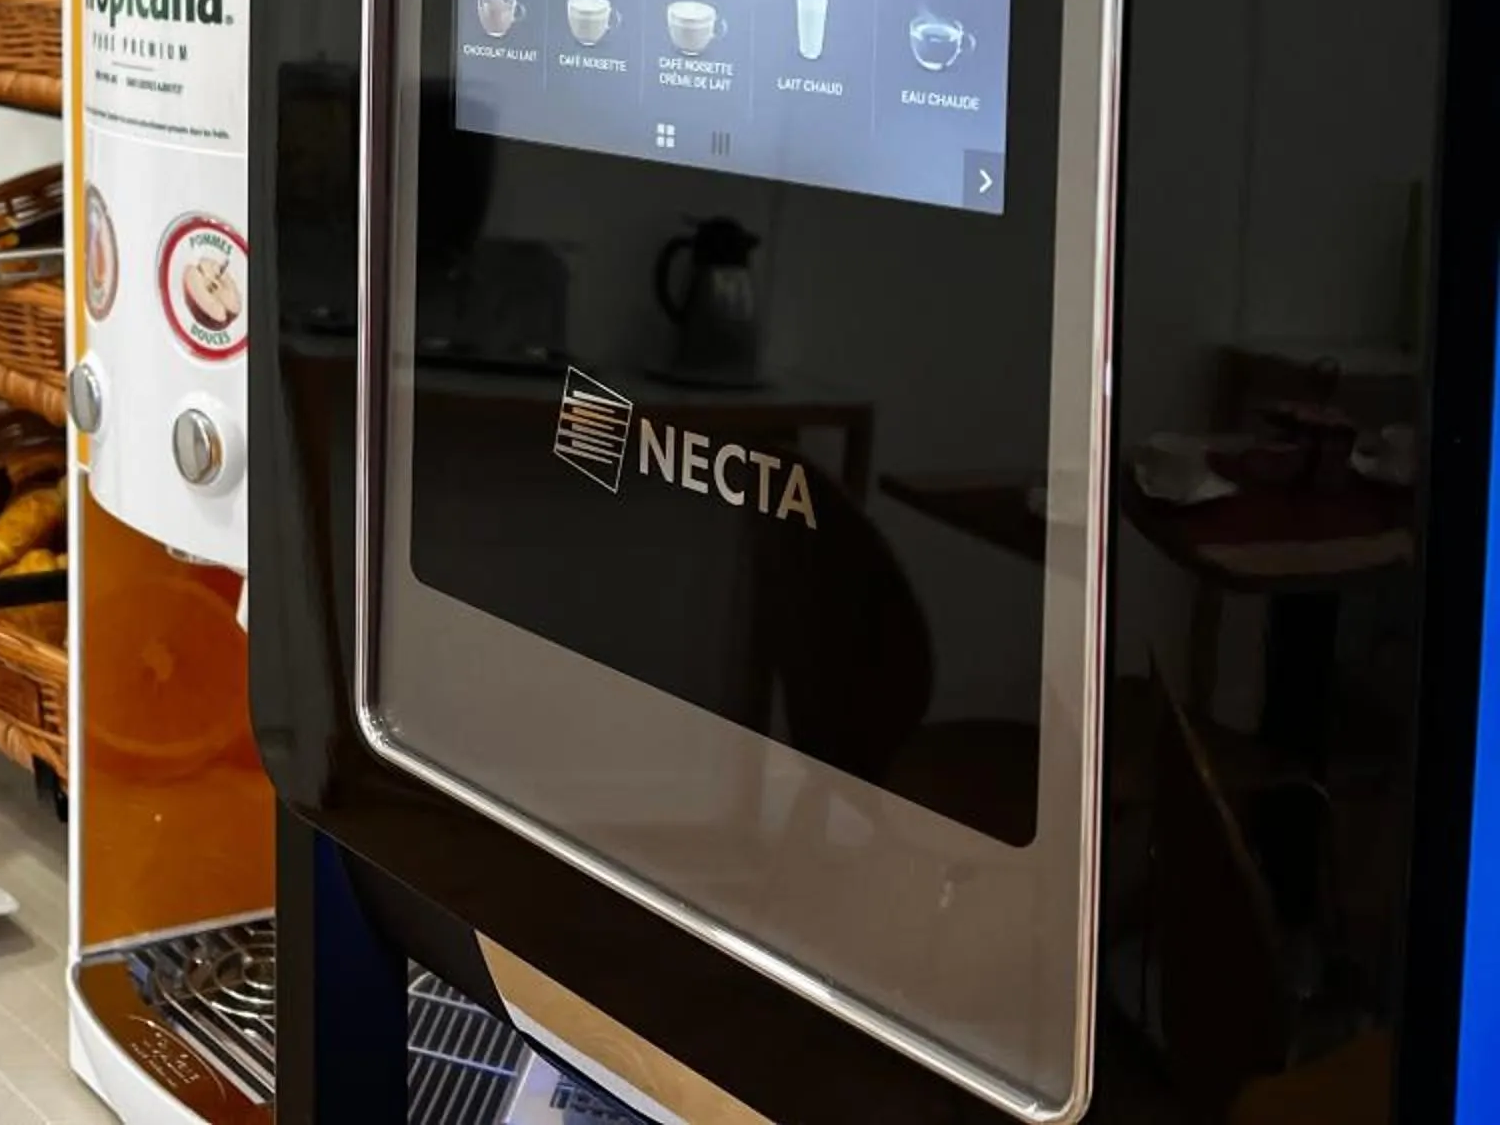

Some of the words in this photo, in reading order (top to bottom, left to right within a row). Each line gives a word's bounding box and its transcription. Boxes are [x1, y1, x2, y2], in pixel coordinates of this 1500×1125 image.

[123, 36, 188, 62] PREMIUM
[463, 44, 506, 58] CHOCOLAT
[506, 47, 519, 60] AU
[519, 50, 538, 62] LAIT
[582, 57, 627, 72] NOISETTE
[685, 60, 734, 76] NOISETTE
[694, 76, 708, 89] DE
[709, 78, 732, 92] LAIT
[777, 78, 802, 91] LAIT
[803, 79, 843, 96] CHAUD
[901, 90, 926, 106] EAU
[927, 92, 981, 111] CHAUDE
[189, 233, 234, 254] POMMES
[638, 417, 817, 530] NECTA
